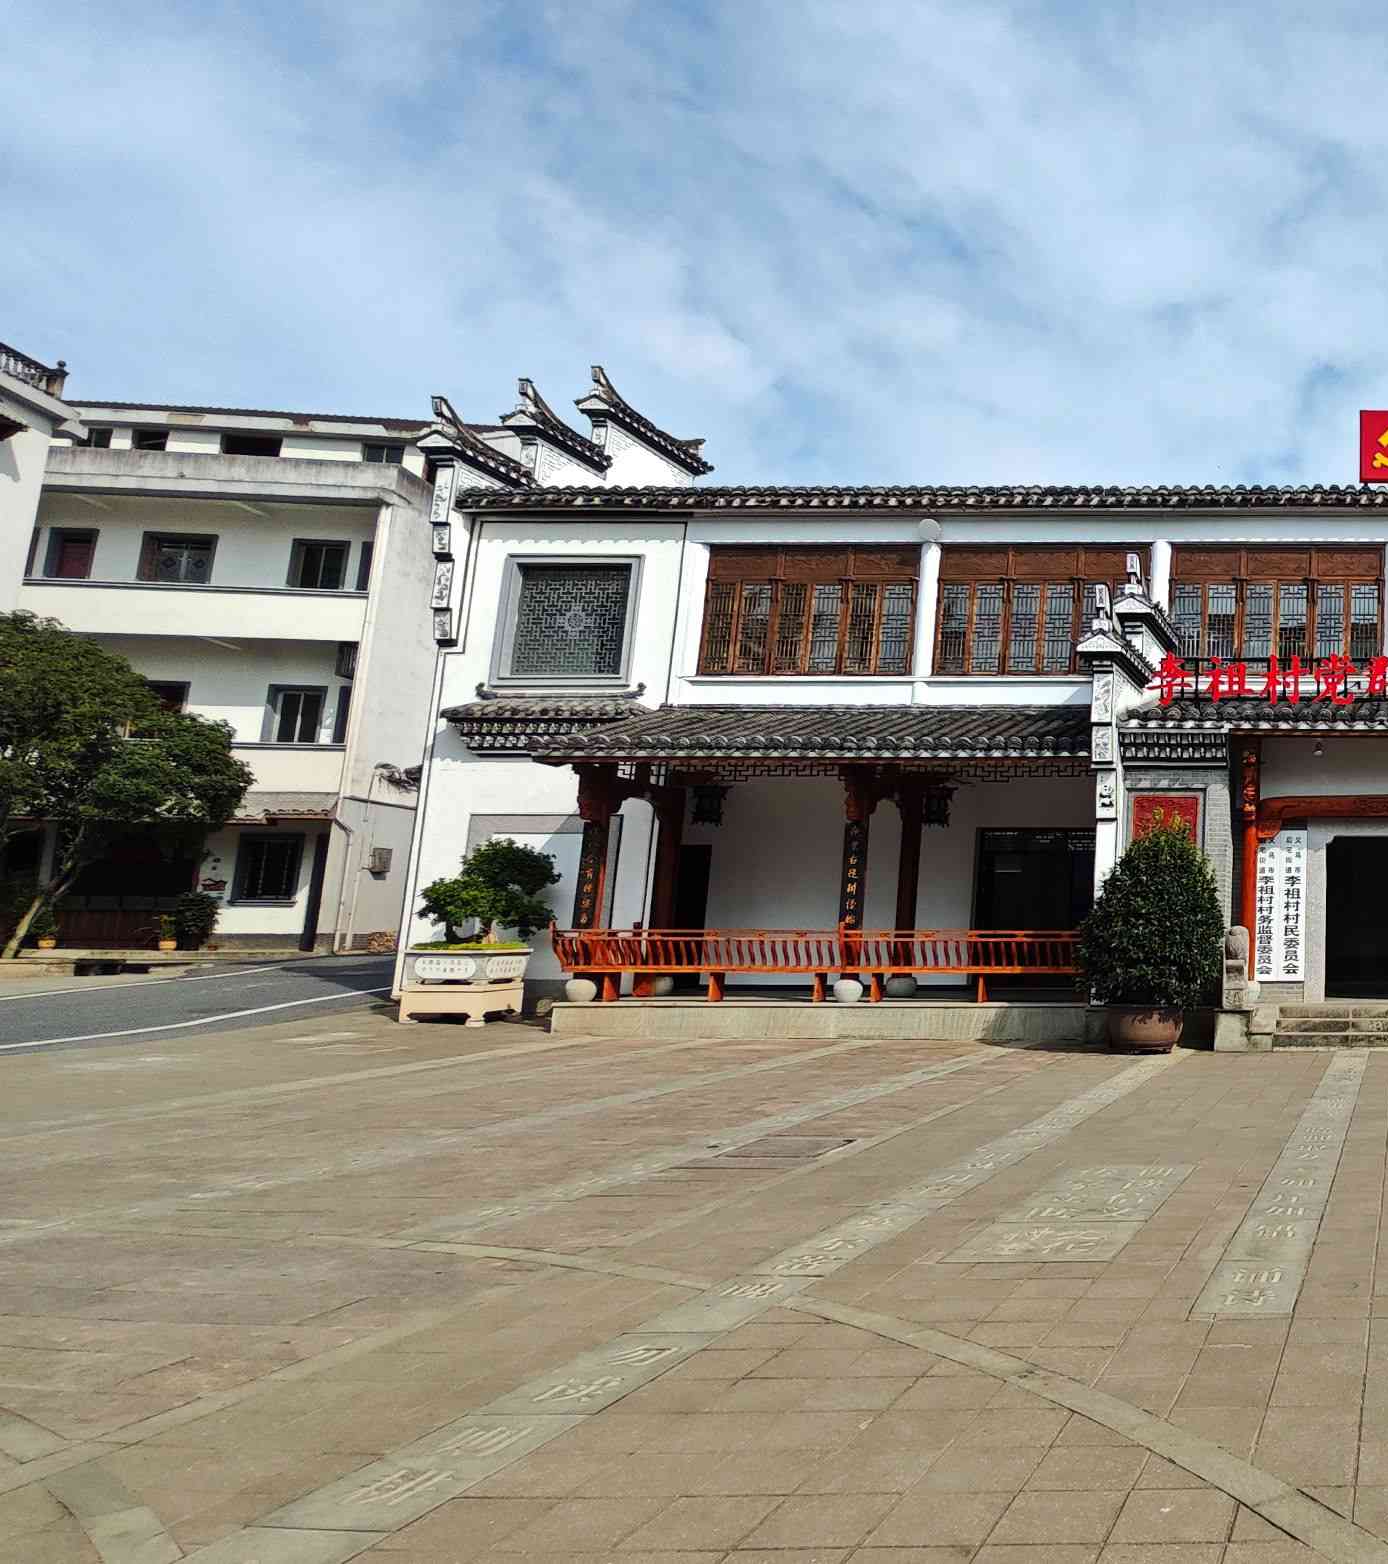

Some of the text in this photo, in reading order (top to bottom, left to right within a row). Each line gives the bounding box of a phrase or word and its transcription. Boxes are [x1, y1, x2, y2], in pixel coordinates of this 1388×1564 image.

[1256, 876, 1275, 975] 李祖村村务监督委员会
[1282, 876, 1301, 975] 李祖村村民委员会
